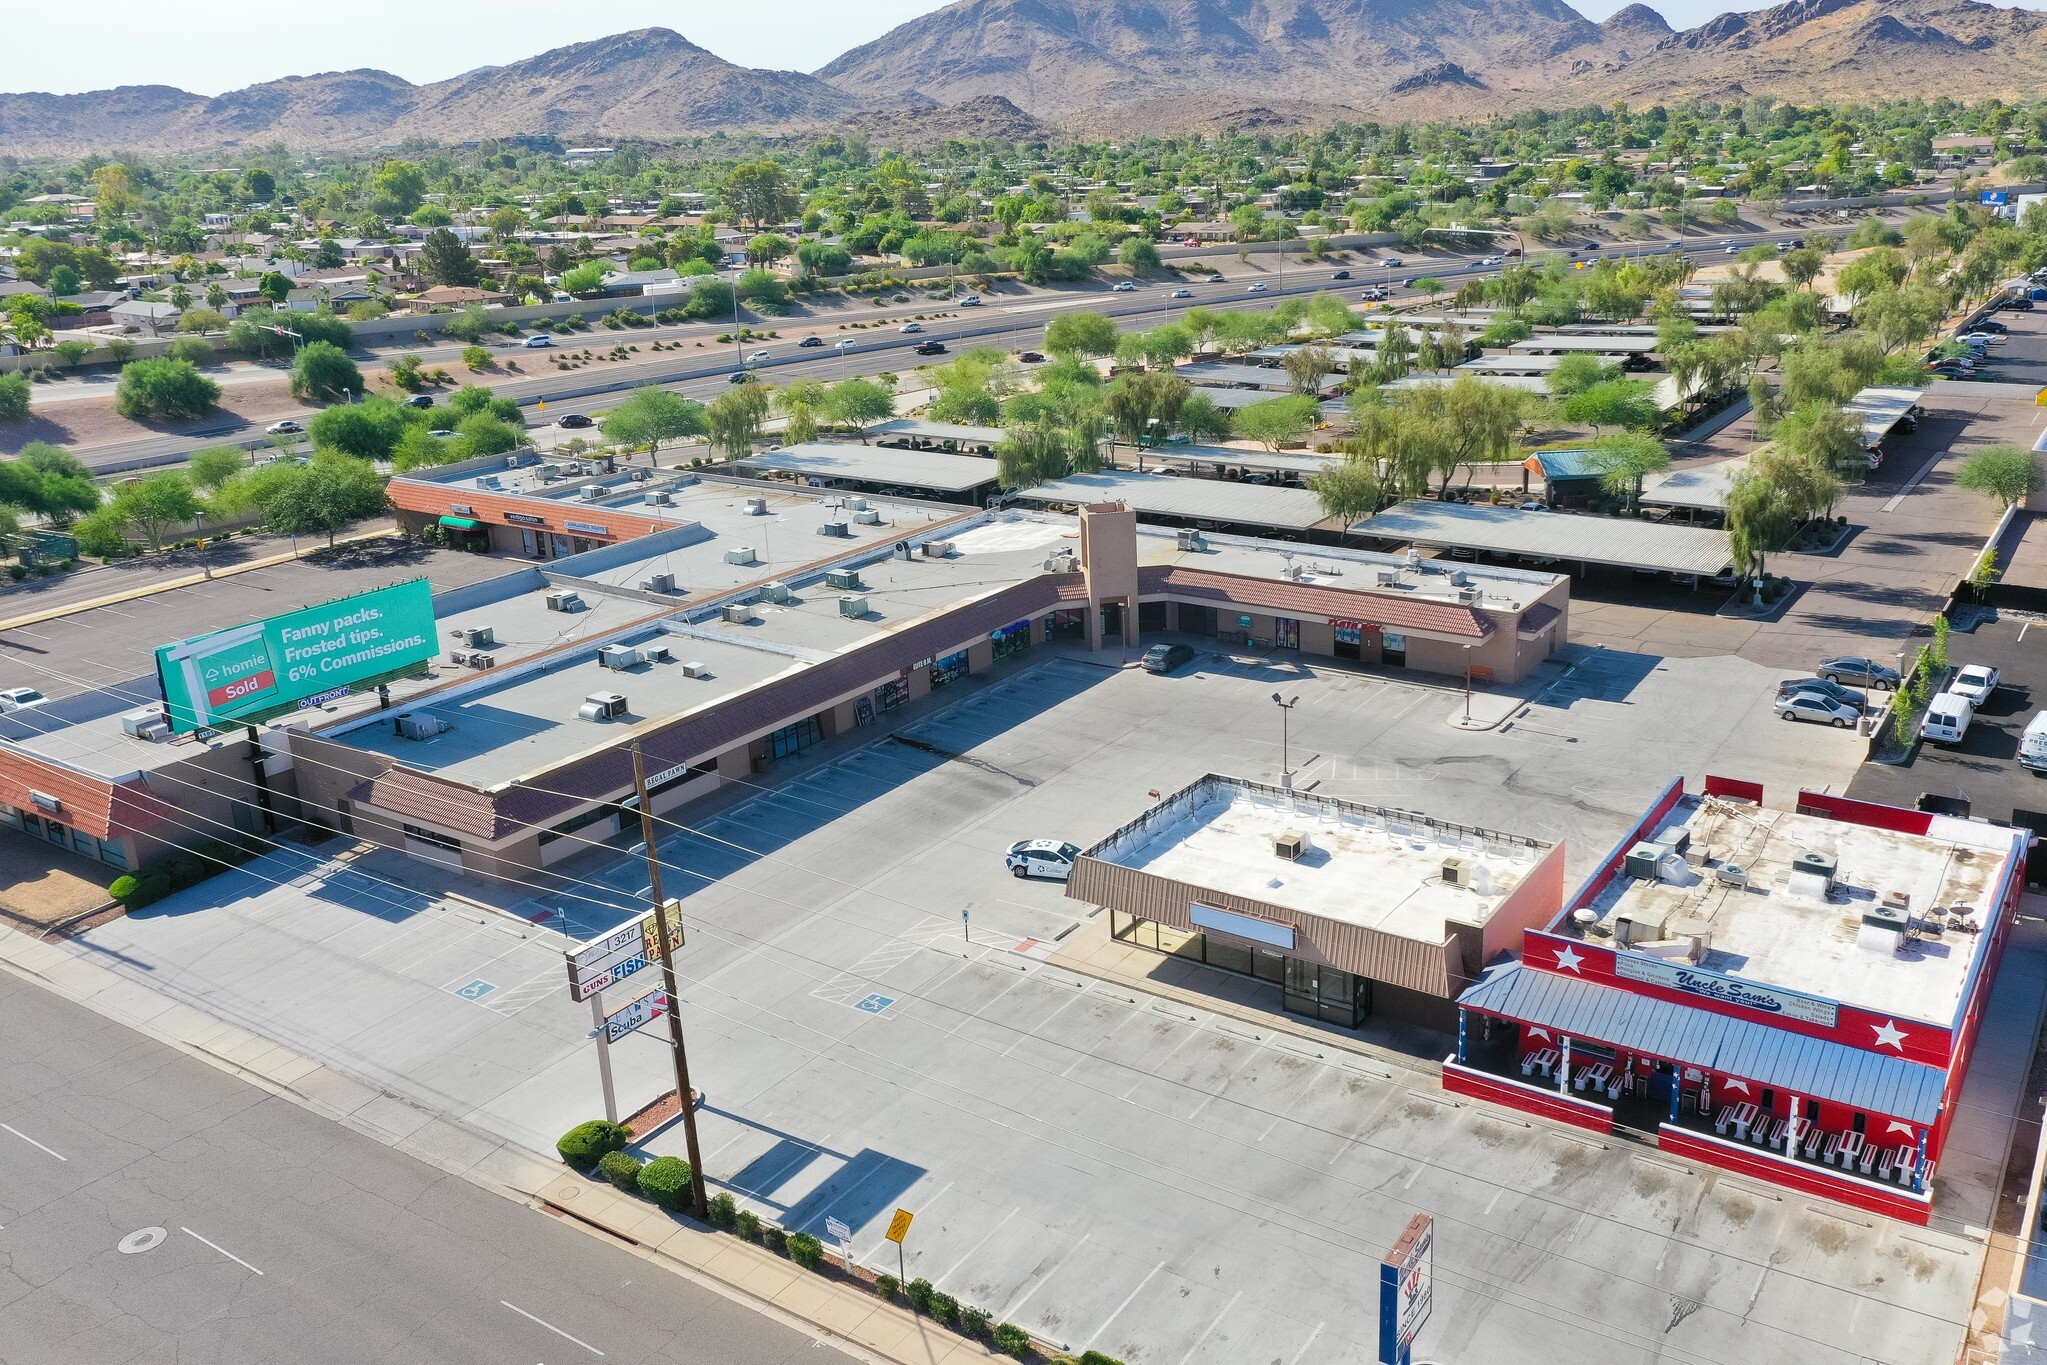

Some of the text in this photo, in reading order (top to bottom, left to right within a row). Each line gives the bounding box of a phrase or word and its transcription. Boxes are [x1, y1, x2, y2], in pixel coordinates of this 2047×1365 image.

[281, 606, 384, 644] Fanny packs.
[285, 628, 384, 663] Frosted tips.
[222, 654, 265, 677] homie
[288, 635, 426, 682] 6% Commissions.
[225, 678, 259, 700] Sold
[300, 687, 348, 707] OUTFRONT
[647, 763, 685, 786] REGAL PAWN
[614, 929, 635, 946] 3217
[613, 953, 644, 980] FISH
[583, 975, 609, 994] GUNS
[1676, 971, 1778, 1005] Uncle Sam's
[1789, 1002, 1830, 1015] Chicken Wings
[1811, 1013, 1830, 1021] Salads
[611, 1014, 642, 1037] Scuba
[1397, 1307, 1416, 1339] SINCE
[1417, 1285, 1431, 1307] 1980
